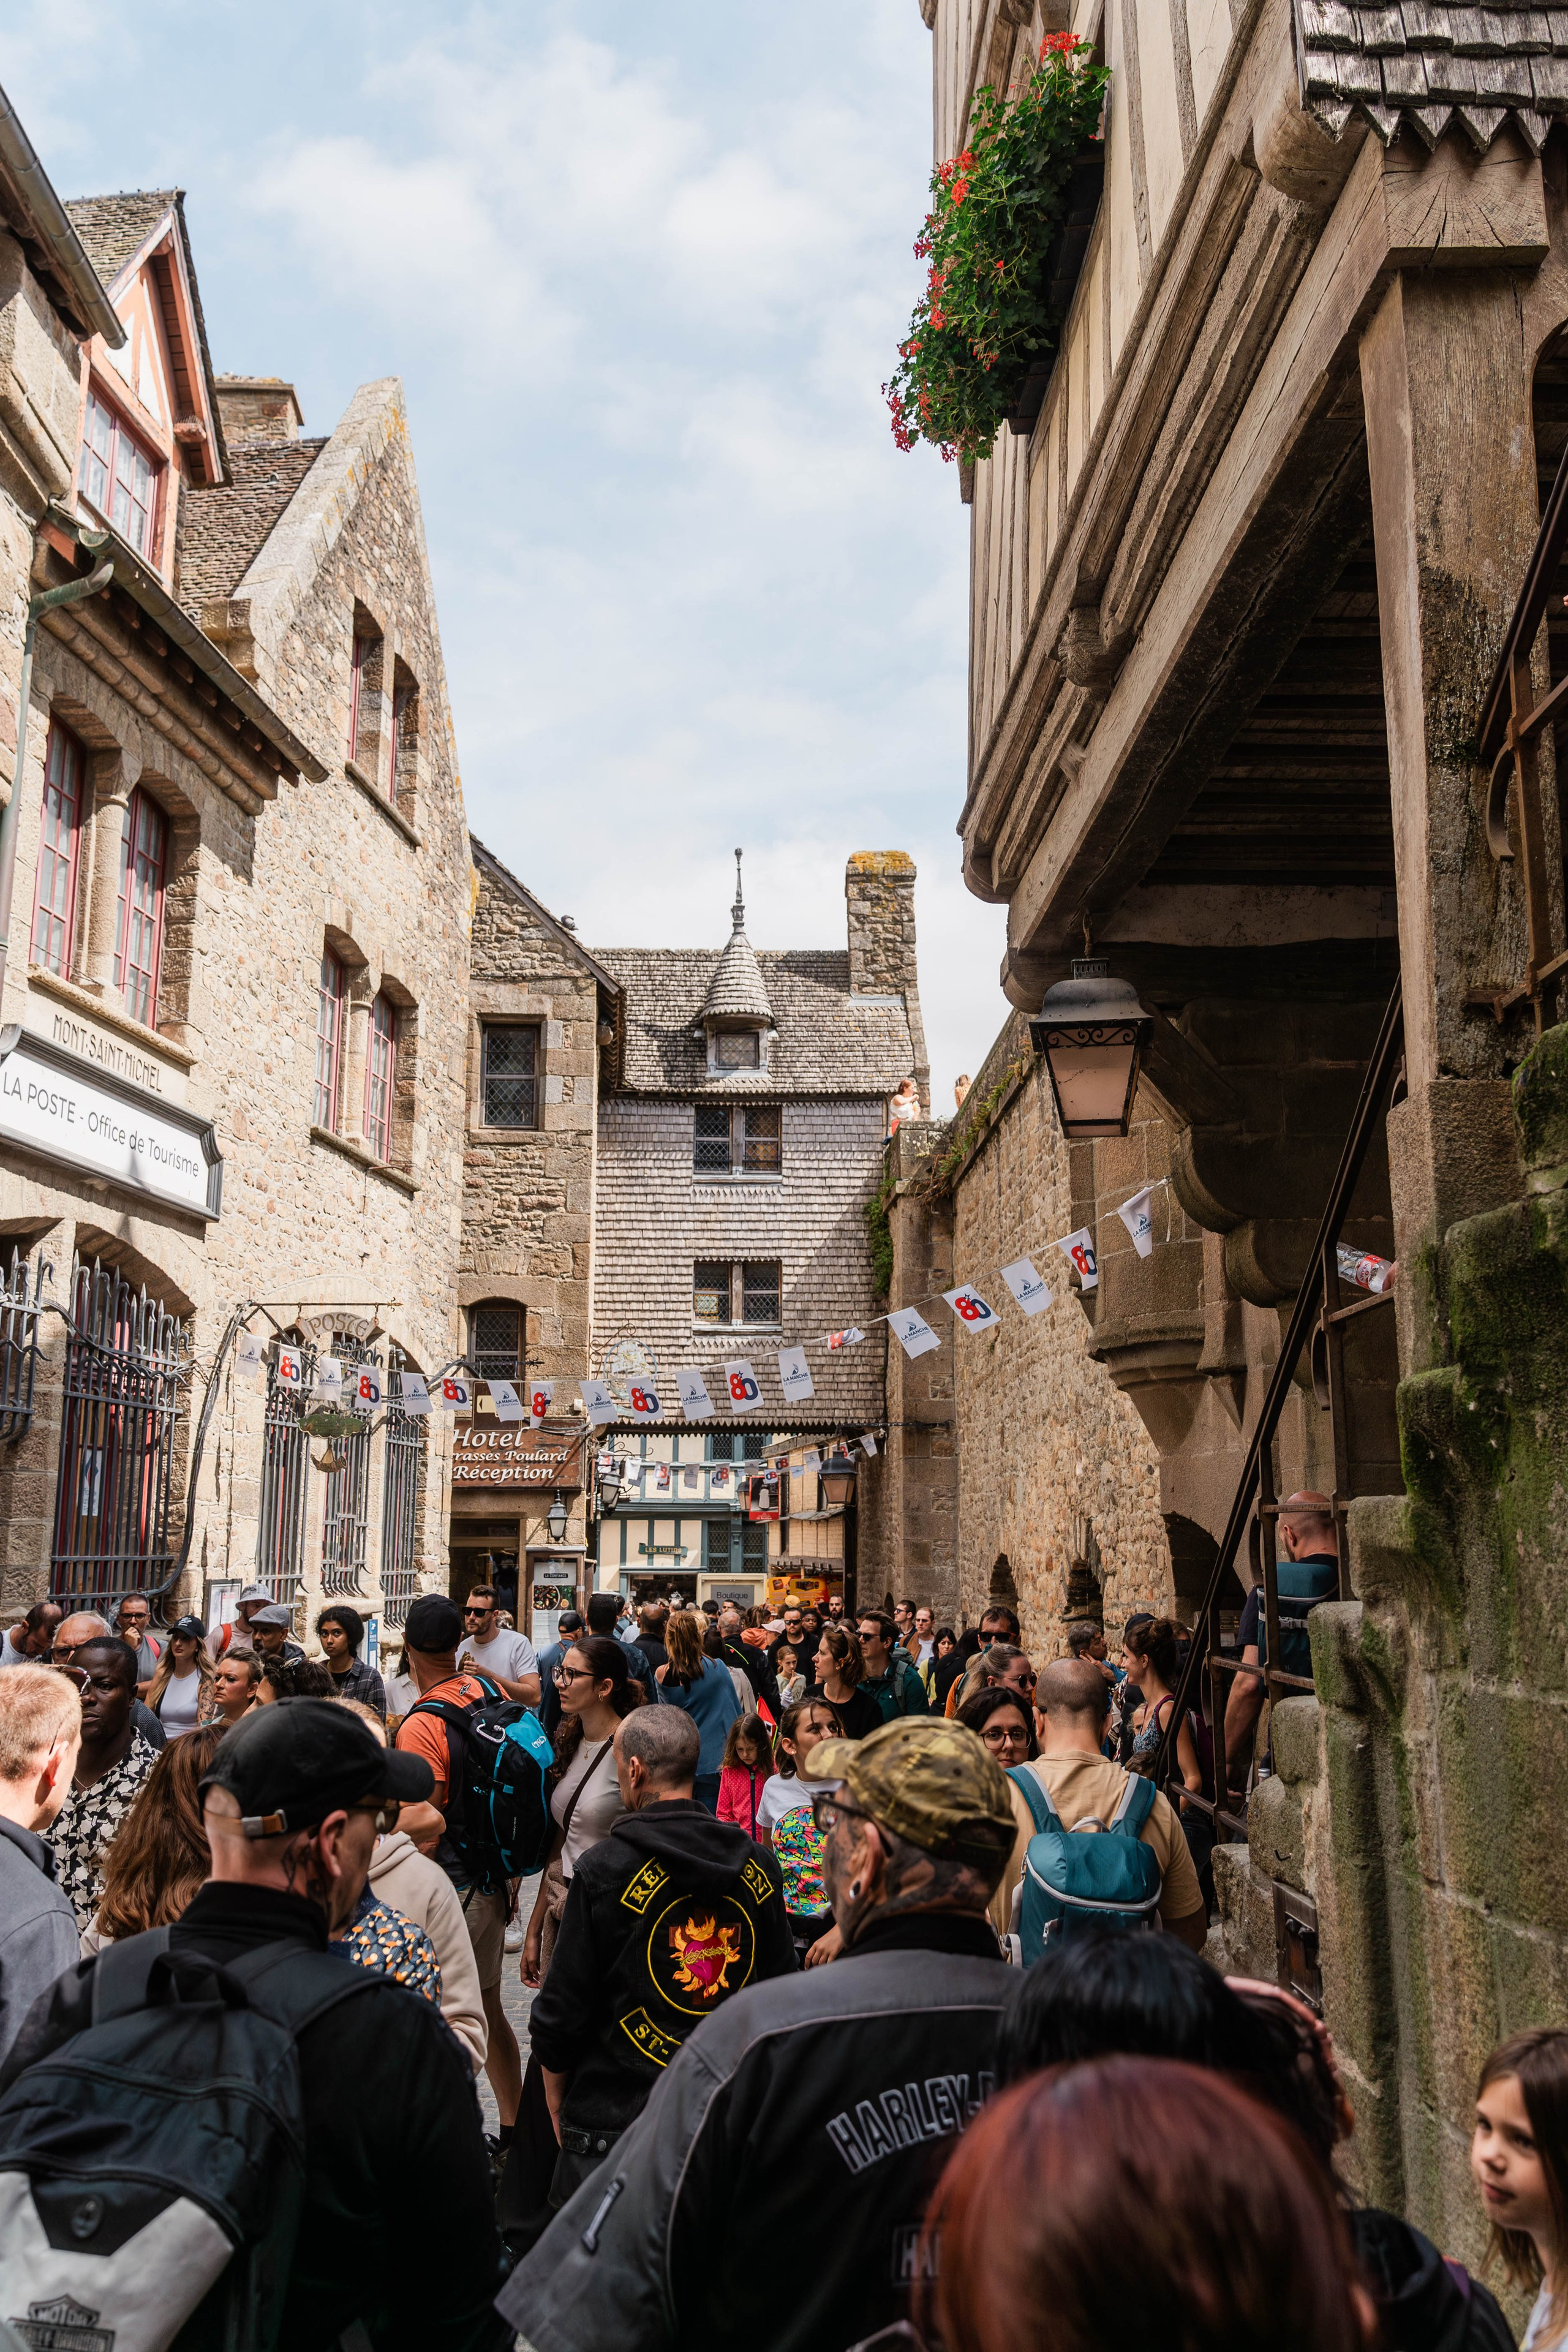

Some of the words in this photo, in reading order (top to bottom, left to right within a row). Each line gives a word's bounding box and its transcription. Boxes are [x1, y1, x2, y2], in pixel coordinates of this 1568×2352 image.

[3, 1072, 22, 1101] LA
[28, 1083, 76, 1123] POSTE
[88, 1111, 126, 1145] Office
[129, 1130, 145, 1153] de
[148, 1137, 199, 1177] Tourisme
[1071, 1245, 1098, 1275] 80
[1024, 1281, 1044, 1295] MANCHE
[955, 1297, 991, 1321] 80
[307, 1313, 369, 1336] POSTE
[908, 1326, 929, 1338] MANCHE
[908, 1330, 931, 1343] DÉPARTEMENT
[281, 1355, 300, 1382] 80
[359, 1375, 379, 1403] 80
[443, 1378, 467, 1404] 80
[729, 1373, 759, 1401] 80
[631, 1387, 659, 1414] 80
[453, 1427, 532, 1448] Hotel
[505, 1450, 571, 1461] Poulard
[453, 1463, 554, 1483] Réception
